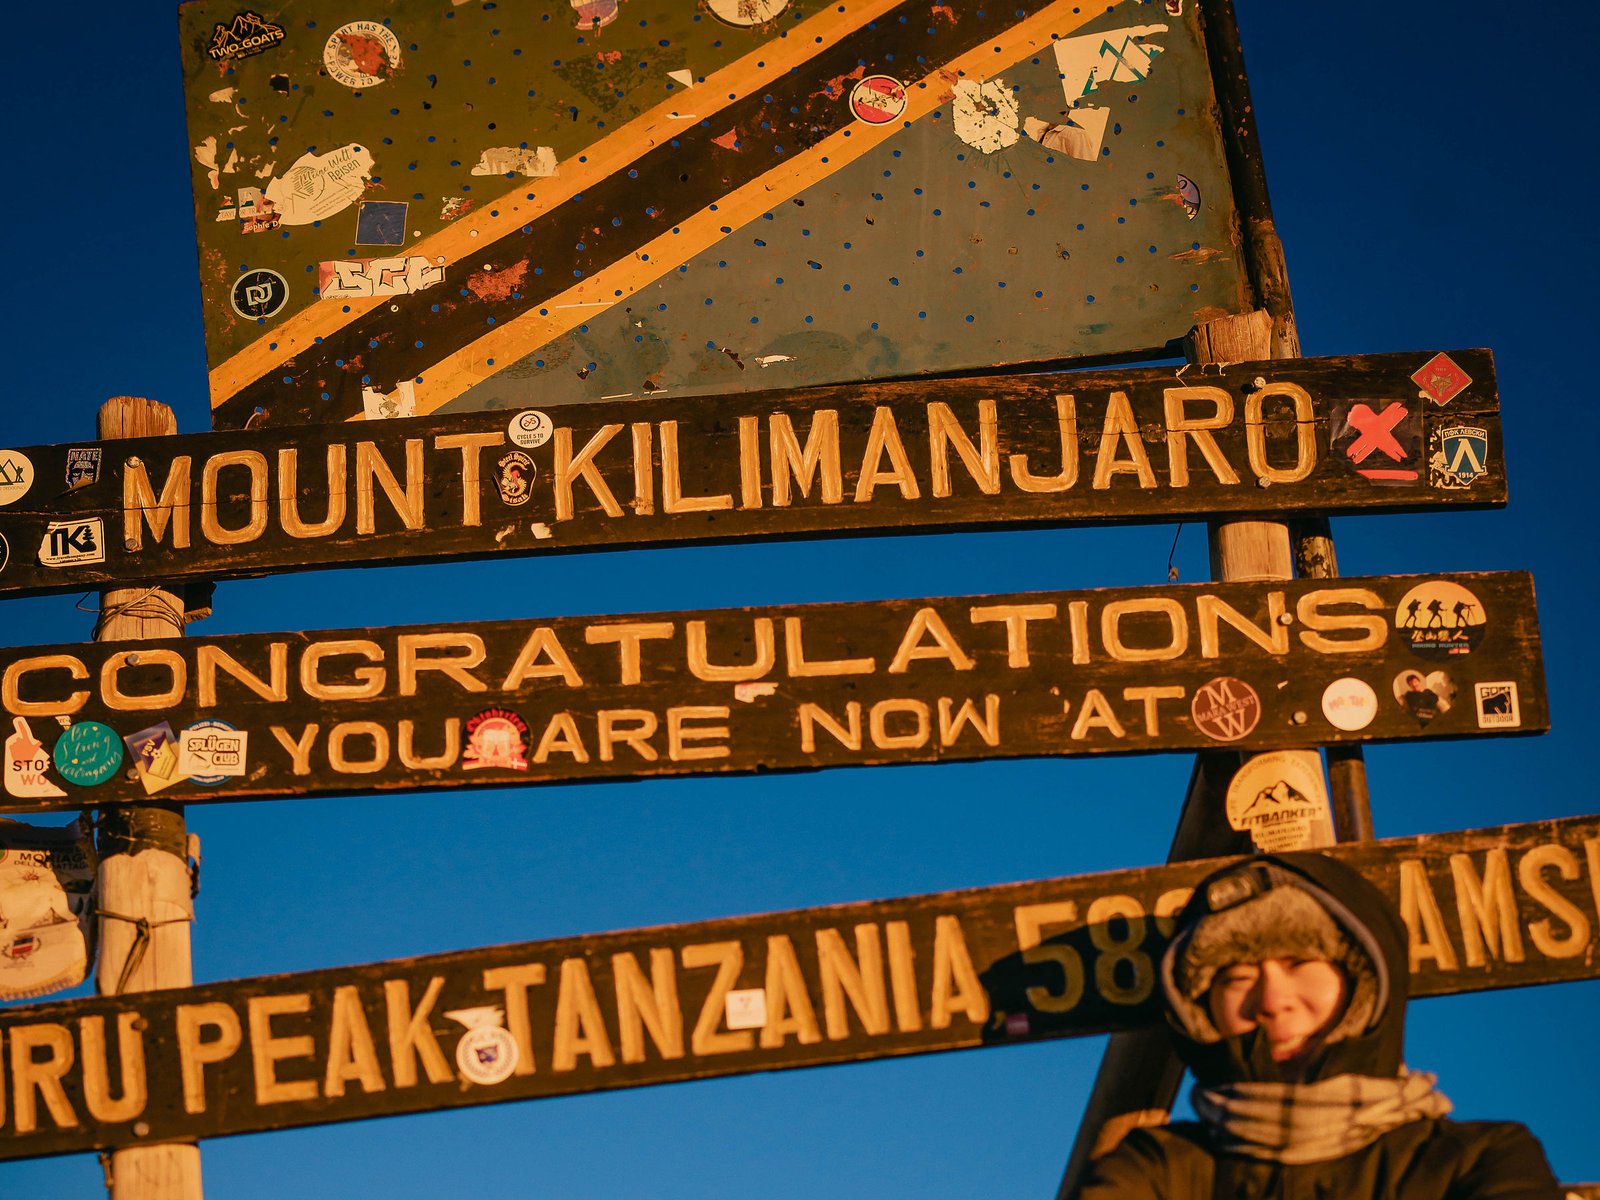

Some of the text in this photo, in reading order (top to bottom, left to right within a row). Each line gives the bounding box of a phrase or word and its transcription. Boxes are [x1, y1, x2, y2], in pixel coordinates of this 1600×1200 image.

[328, 25, 354, 50] SPRT
[357, 23, 378, 32] HAS
[328, 147, 352, 168] Welt
[327, 159, 361, 182] Reisen
[123, 381, 1319, 553] MOUNT KILIMANJARO
[1458, 471, 1474, 479] 1914
[1, 588, 1389, 717] CONGRATULATIONS
[271, 686, 1186, 776] YOU ARE NOW AT
[187, 734, 240, 753] SPLÜGEN
[13, 760, 45, 772] STO
[212, 752, 240, 766] CLUB
[21, 774, 47, 786] WO
[0, 1011, 149, 1135] RU
[176, 976, 456, 1115] PEAK
